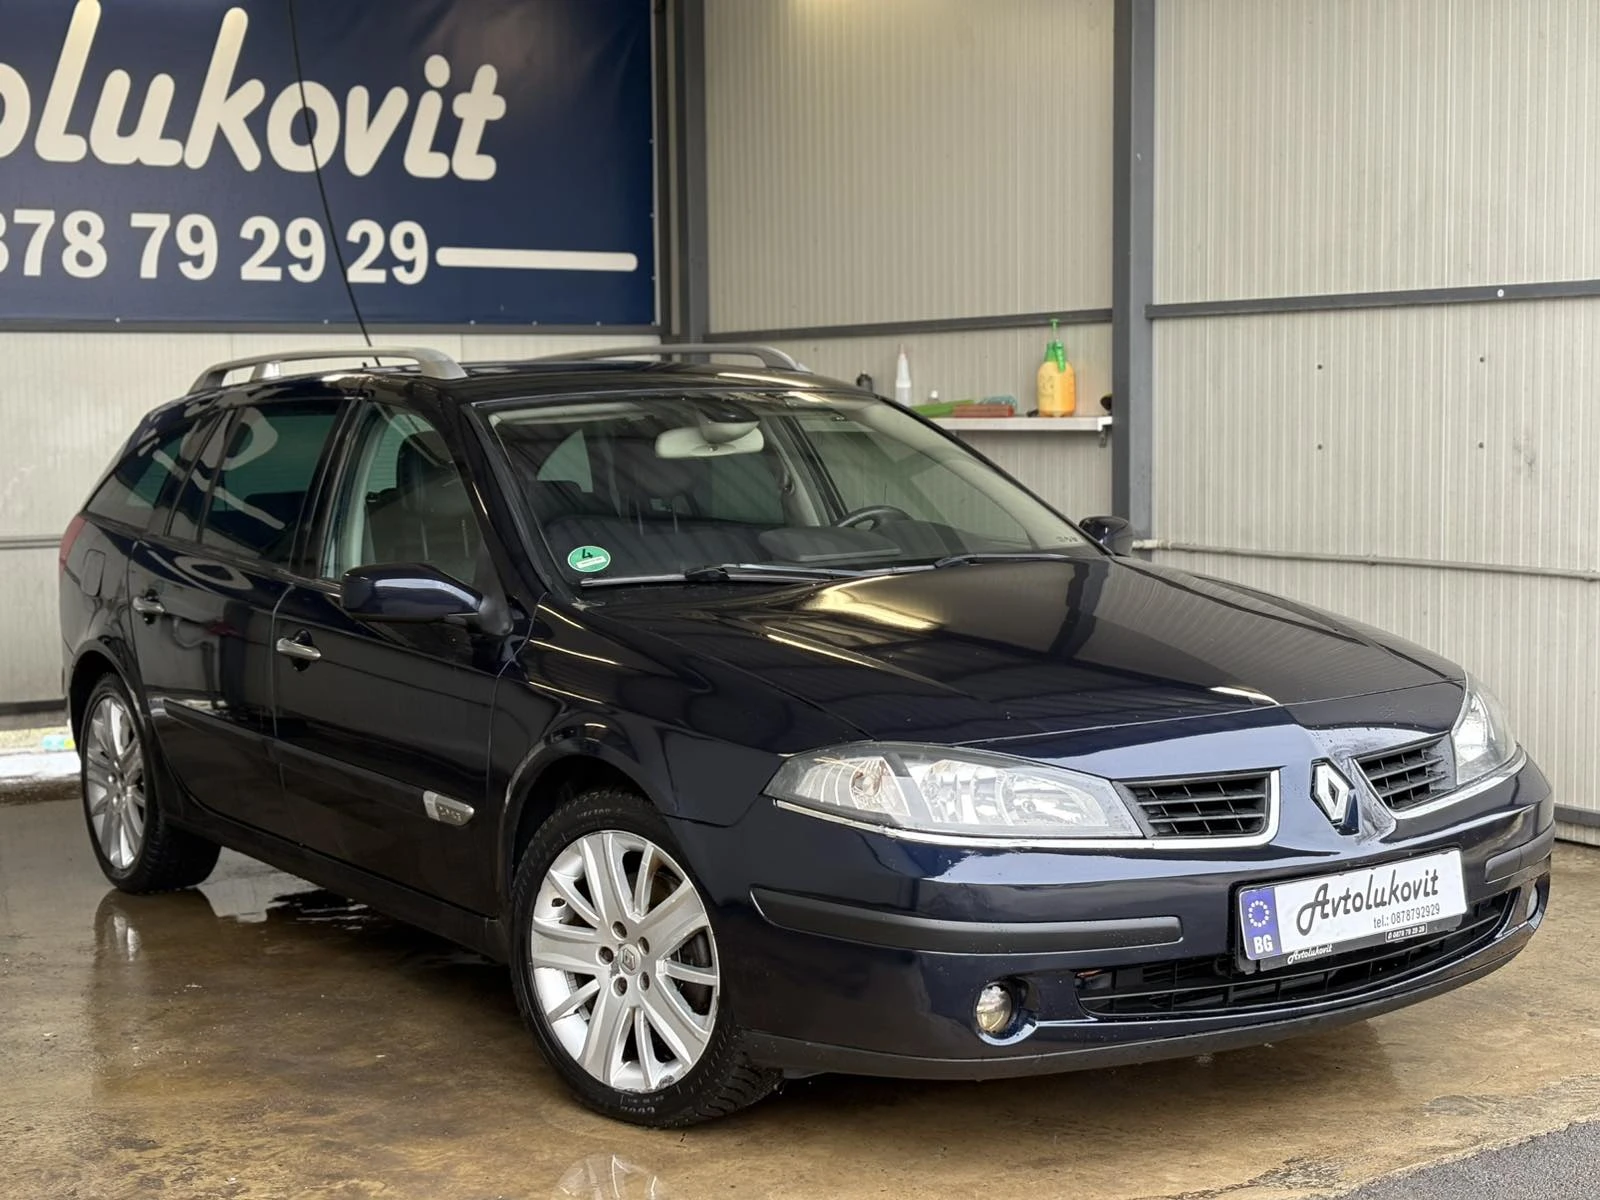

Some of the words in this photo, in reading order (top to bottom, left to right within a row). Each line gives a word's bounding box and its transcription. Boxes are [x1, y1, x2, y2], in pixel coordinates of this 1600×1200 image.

[0, 209, 108, 279] 78
[131, 213, 218, 280] 79
[240, 216, 326, 283] 29
[346, 219, 429, 285] 29
[582, 548, 593, 559] 4
[1296, 869, 1439, 936] Avtolukovit
[1390, 902, 1440, 925] 0878792929
[1254, 934, 1274, 954] BG
